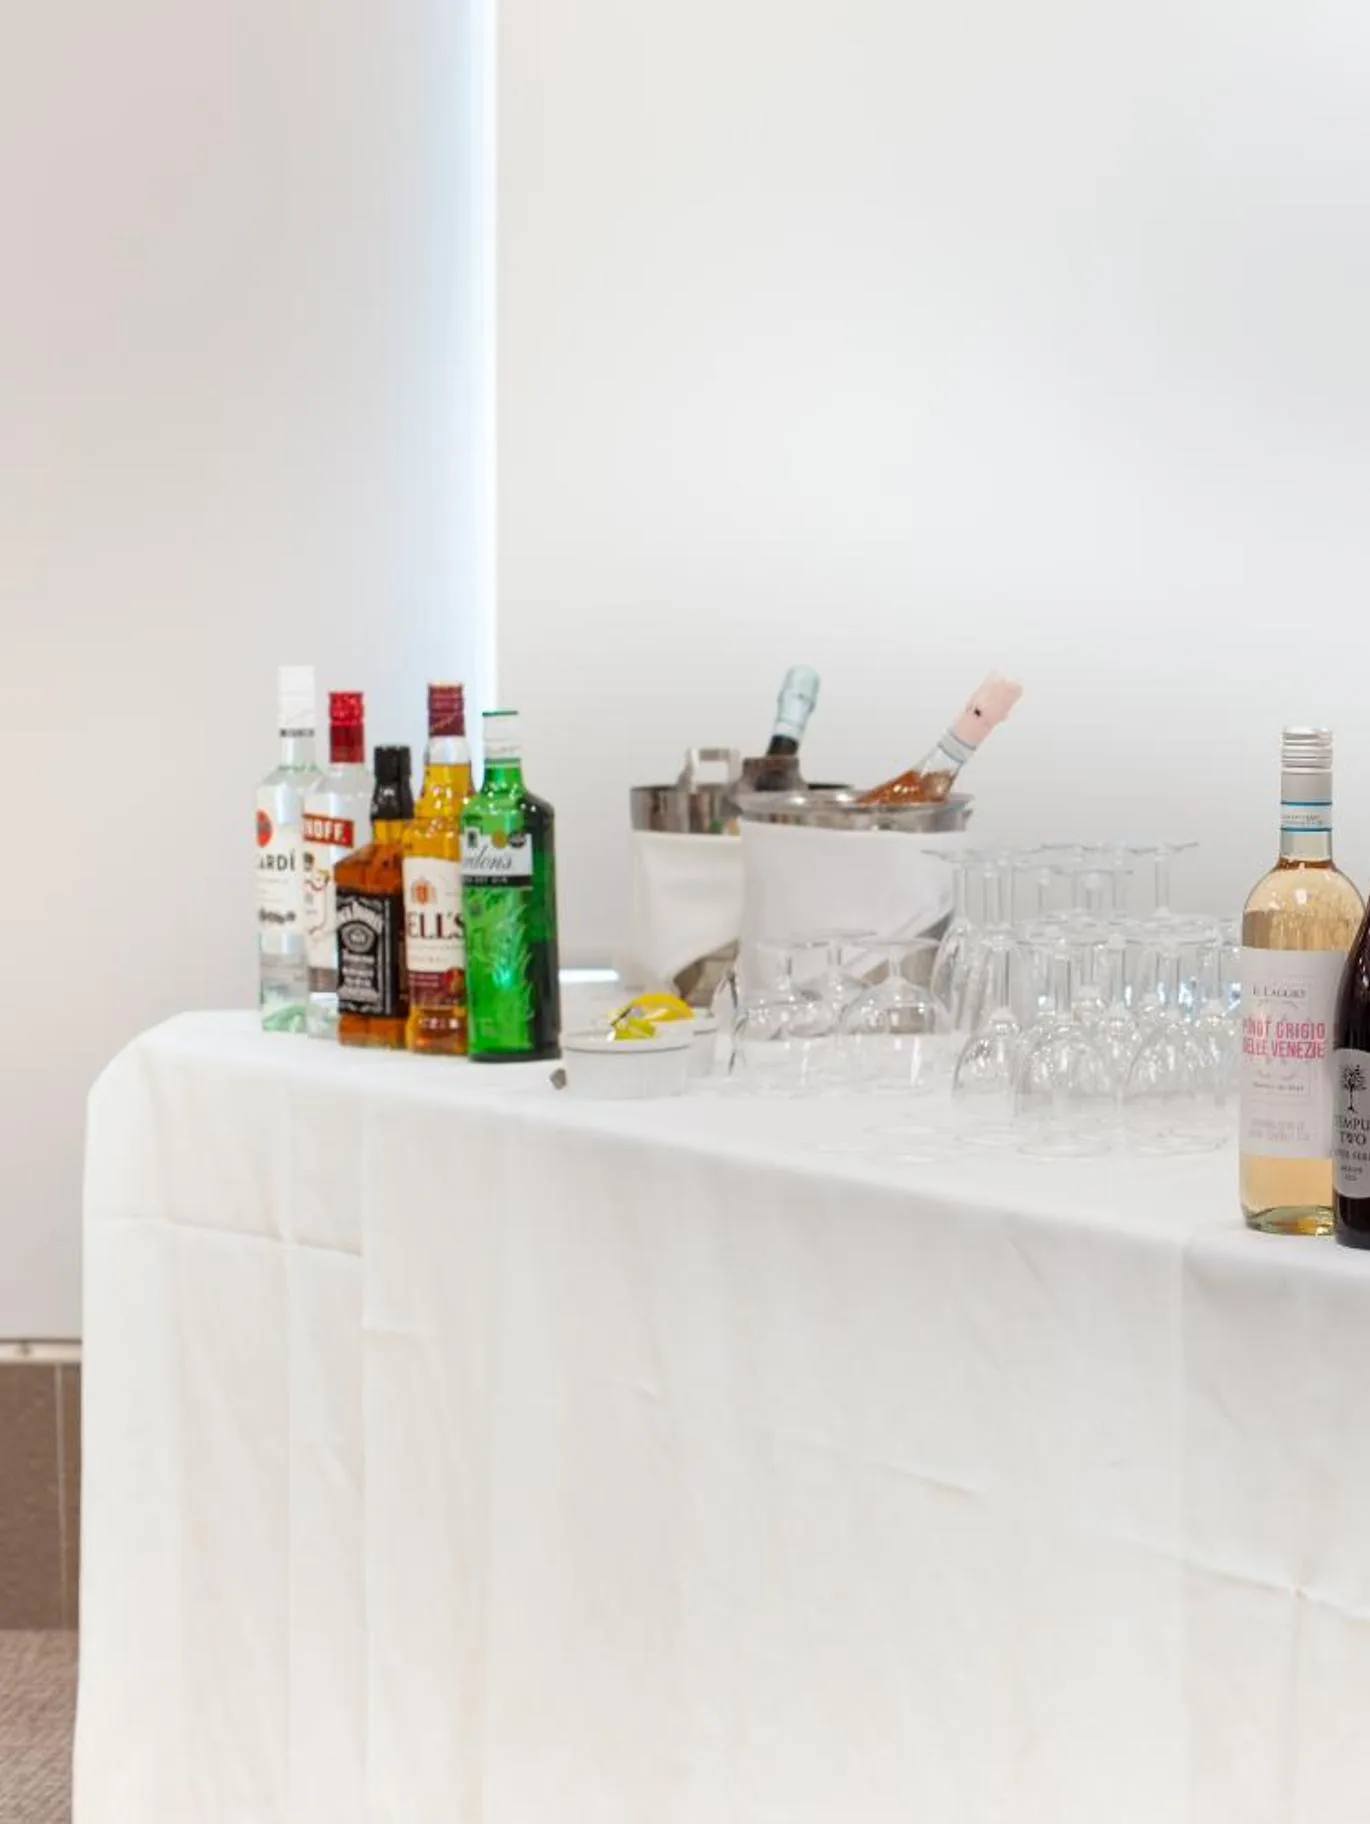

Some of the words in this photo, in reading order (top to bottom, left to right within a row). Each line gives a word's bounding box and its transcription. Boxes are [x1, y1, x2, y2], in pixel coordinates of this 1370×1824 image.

[1276, 1022, 1325, 1041] GRIGIO
[1271, 1040, 1325, 1059] VENEZIE
[1340, 1131, 1366, 1145] TWO
